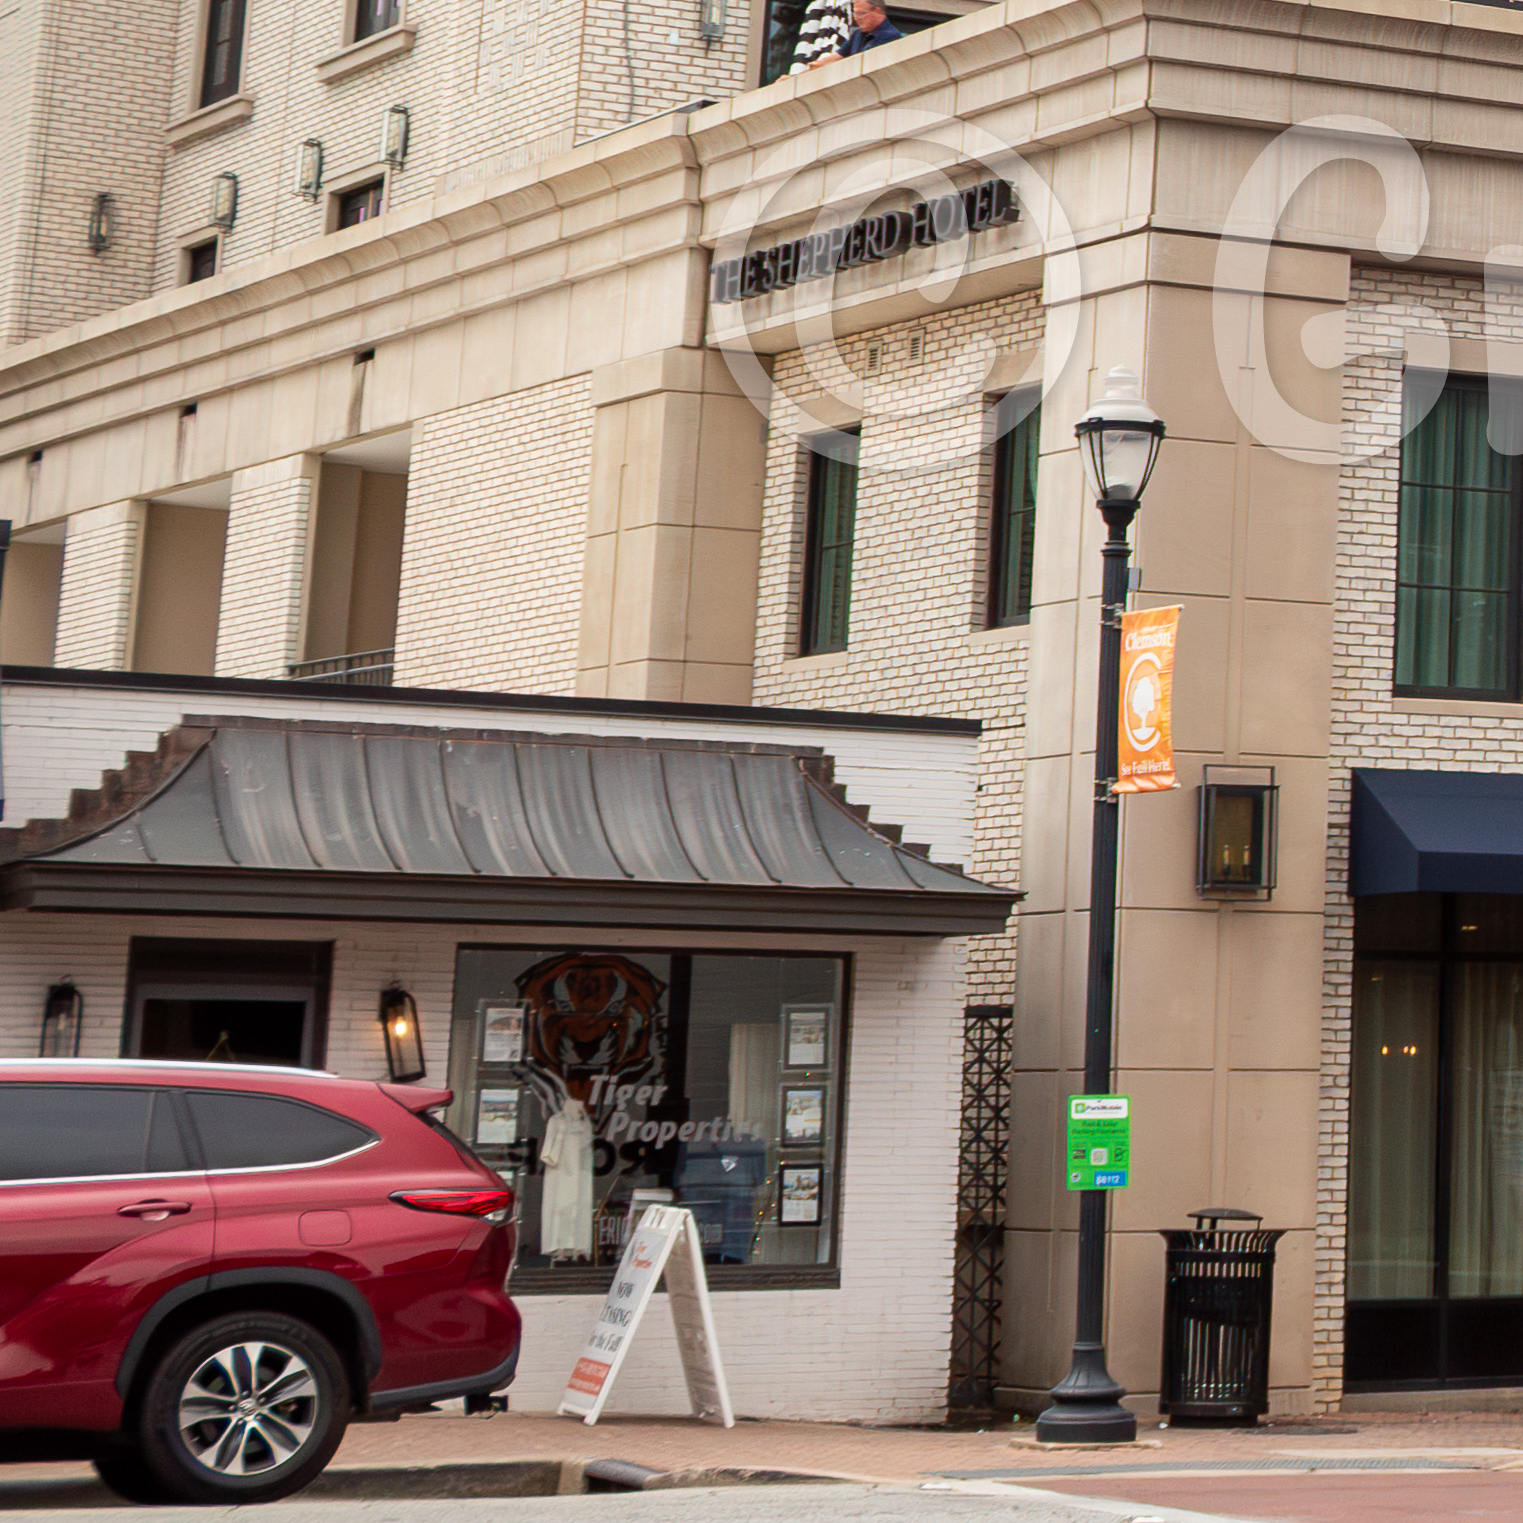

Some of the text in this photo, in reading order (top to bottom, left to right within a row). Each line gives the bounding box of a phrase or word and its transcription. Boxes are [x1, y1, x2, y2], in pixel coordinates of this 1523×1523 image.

[710, 178, 1020, 305] THE SHEPHERD HOTEL
[1125, 631, 1174, 652] Clemson
[1132, 759, 1147, 774] Fall
[588, 1075, 668, 1111] Tiger
